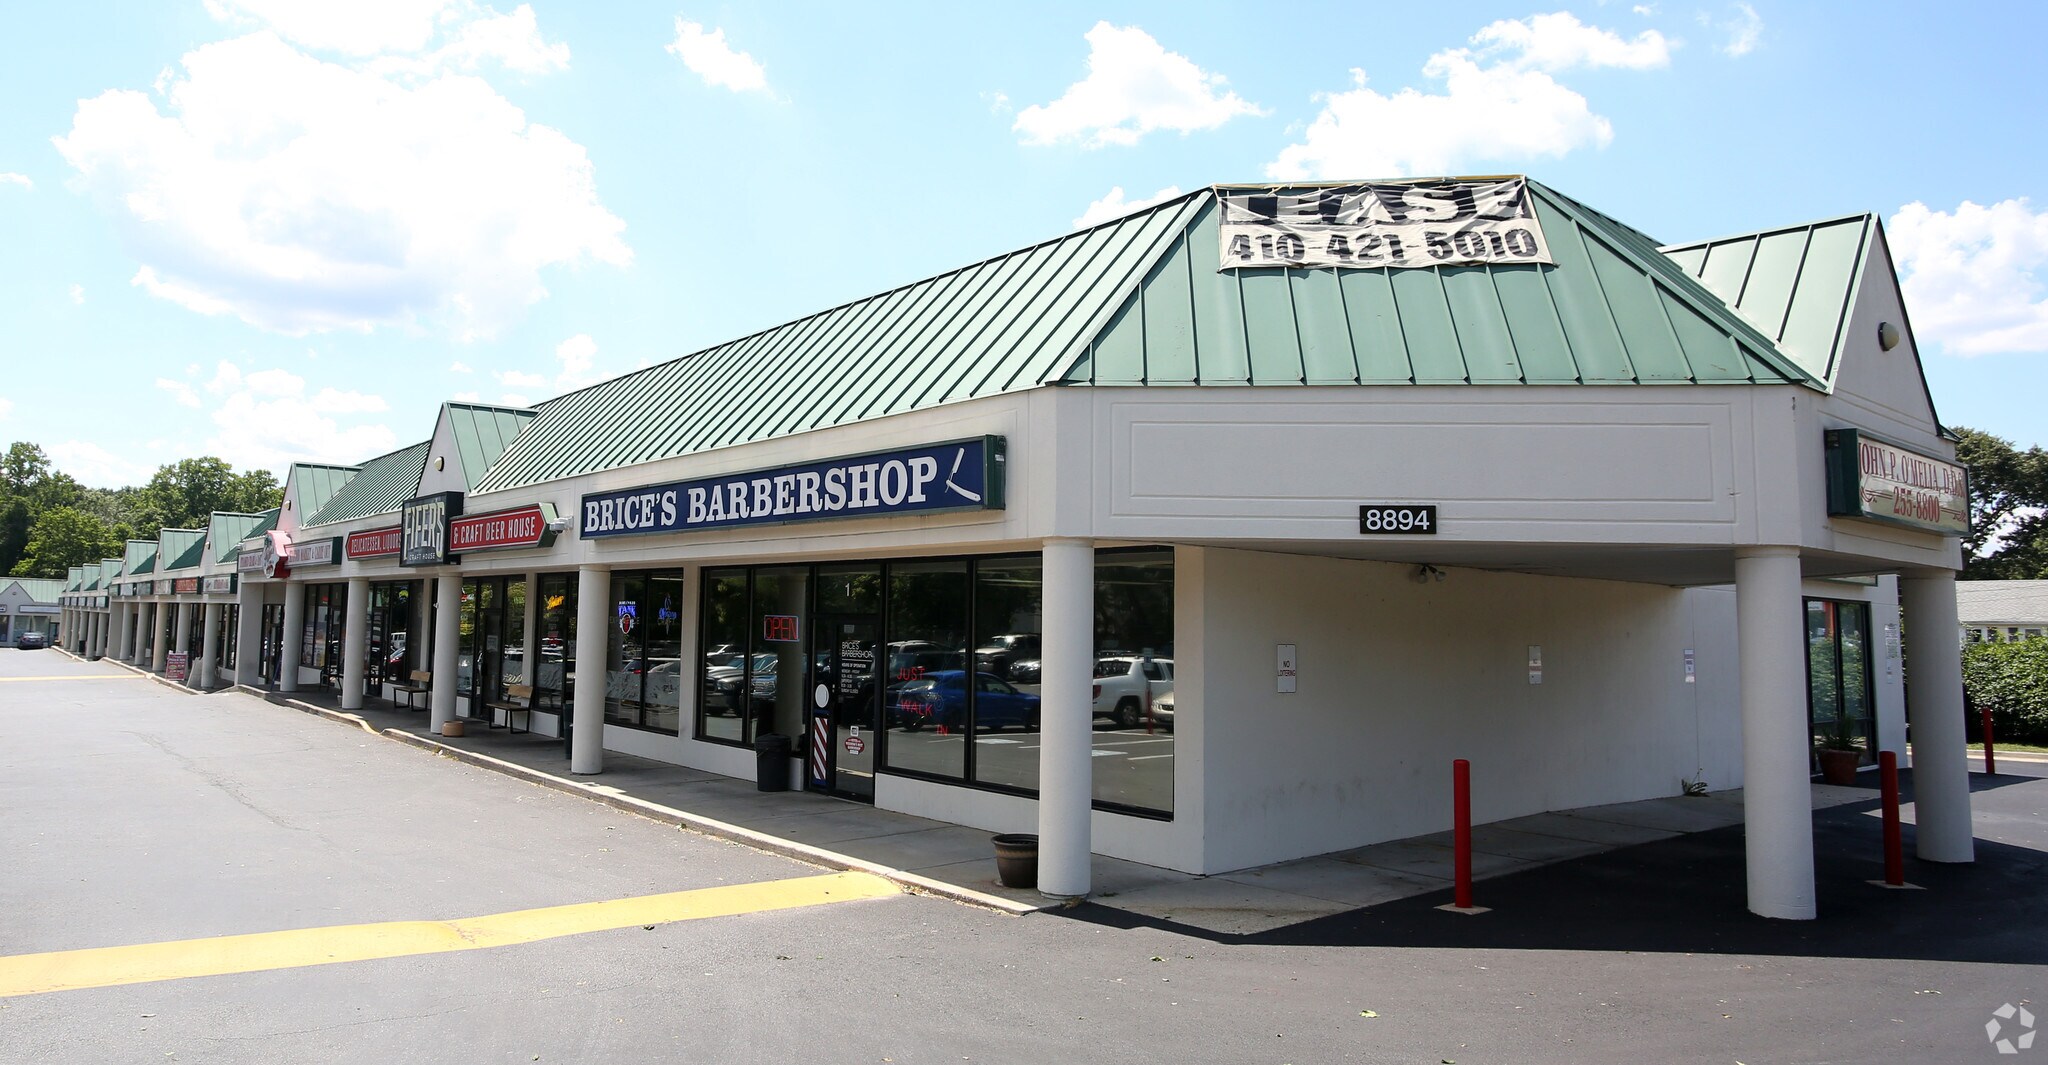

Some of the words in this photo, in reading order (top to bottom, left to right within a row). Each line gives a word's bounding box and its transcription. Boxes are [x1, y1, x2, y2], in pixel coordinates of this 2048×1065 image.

[1227, 181, 1525, 223] LEASE
[1227, 228, 1538, 261] 410-421-5010
[1858, 442, 1886, 481] JOHN
[1890, 451, 1899, 482] P.
[585, 491, 678, 532] BRICE'S
[687, 456, 938, 524] BARBERSHOP
[1893, 486, 1940, 523] 255-8800
[461, 523, 483, 544] CRAFT
[486, 521, 505, 541] BEER
[508, 516, 535, 539] HOUSE
[1366, 509, 1430, 531] 8894
[845, 583, 850, 597] 1
[766, 617, 798, 640] OPEN
[897, 667, 925, 681] JUST
[1283, 660, 1290, 668] NO
[901, 699, 933, 717] WALK
